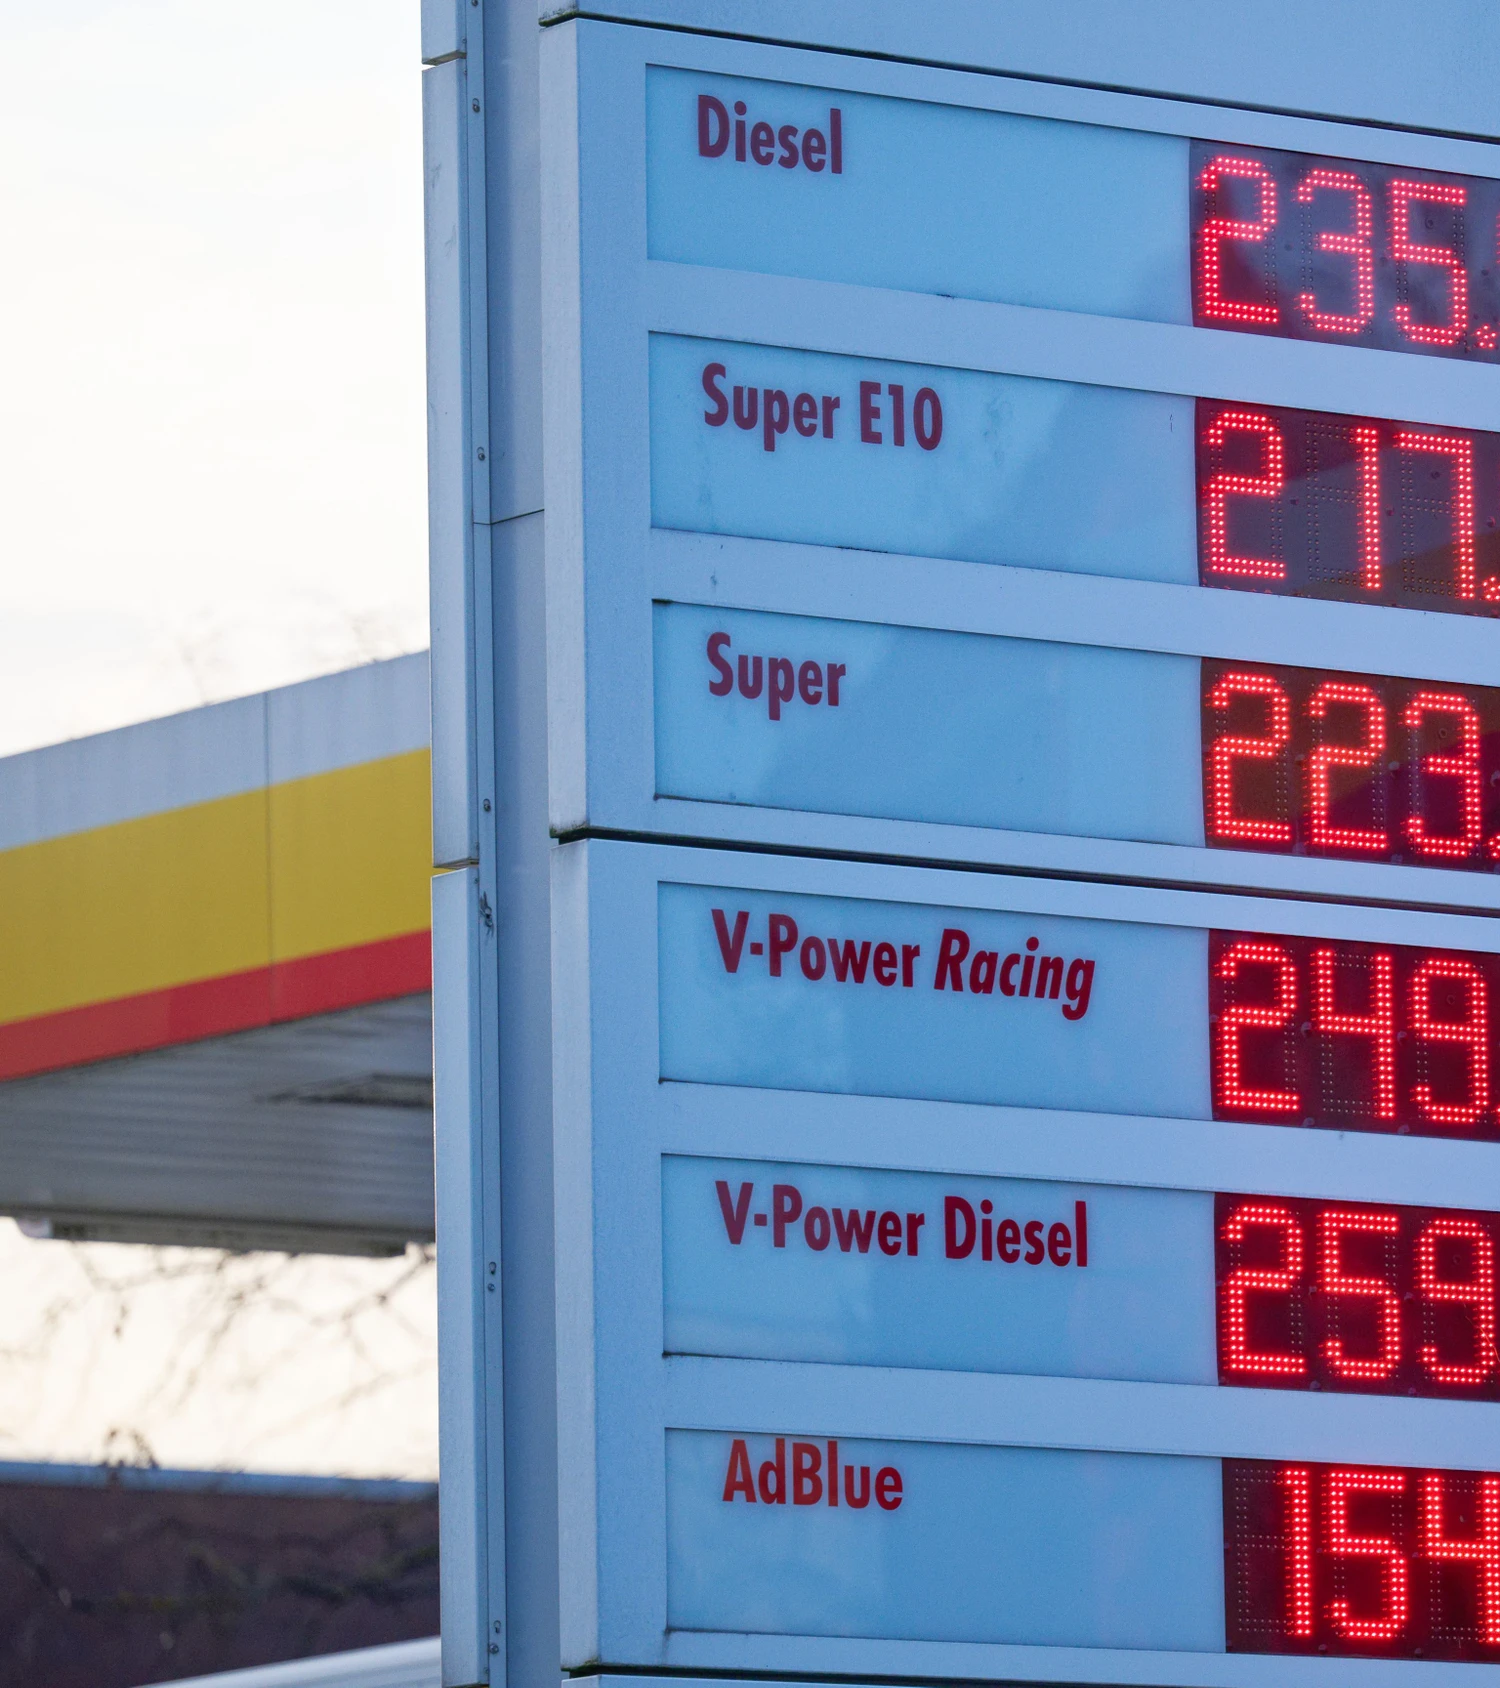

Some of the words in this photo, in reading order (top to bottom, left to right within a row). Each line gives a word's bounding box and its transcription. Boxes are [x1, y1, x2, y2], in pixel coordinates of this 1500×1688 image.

[697, 94, 844, 174] Diesel
[702, 362, 840, 452] Super
[860, 380, 943, 451] E10
[706, 631, 847, 721] Super
[711, 908, 921, 989] V-Power
[934, 927, 1096, 1022] Racing
[715, 1180, 926, 1257] V-Power
[944, 1195, 1089, 1268] Diesel
[721, 1436, 904, 1512] AdBlue
